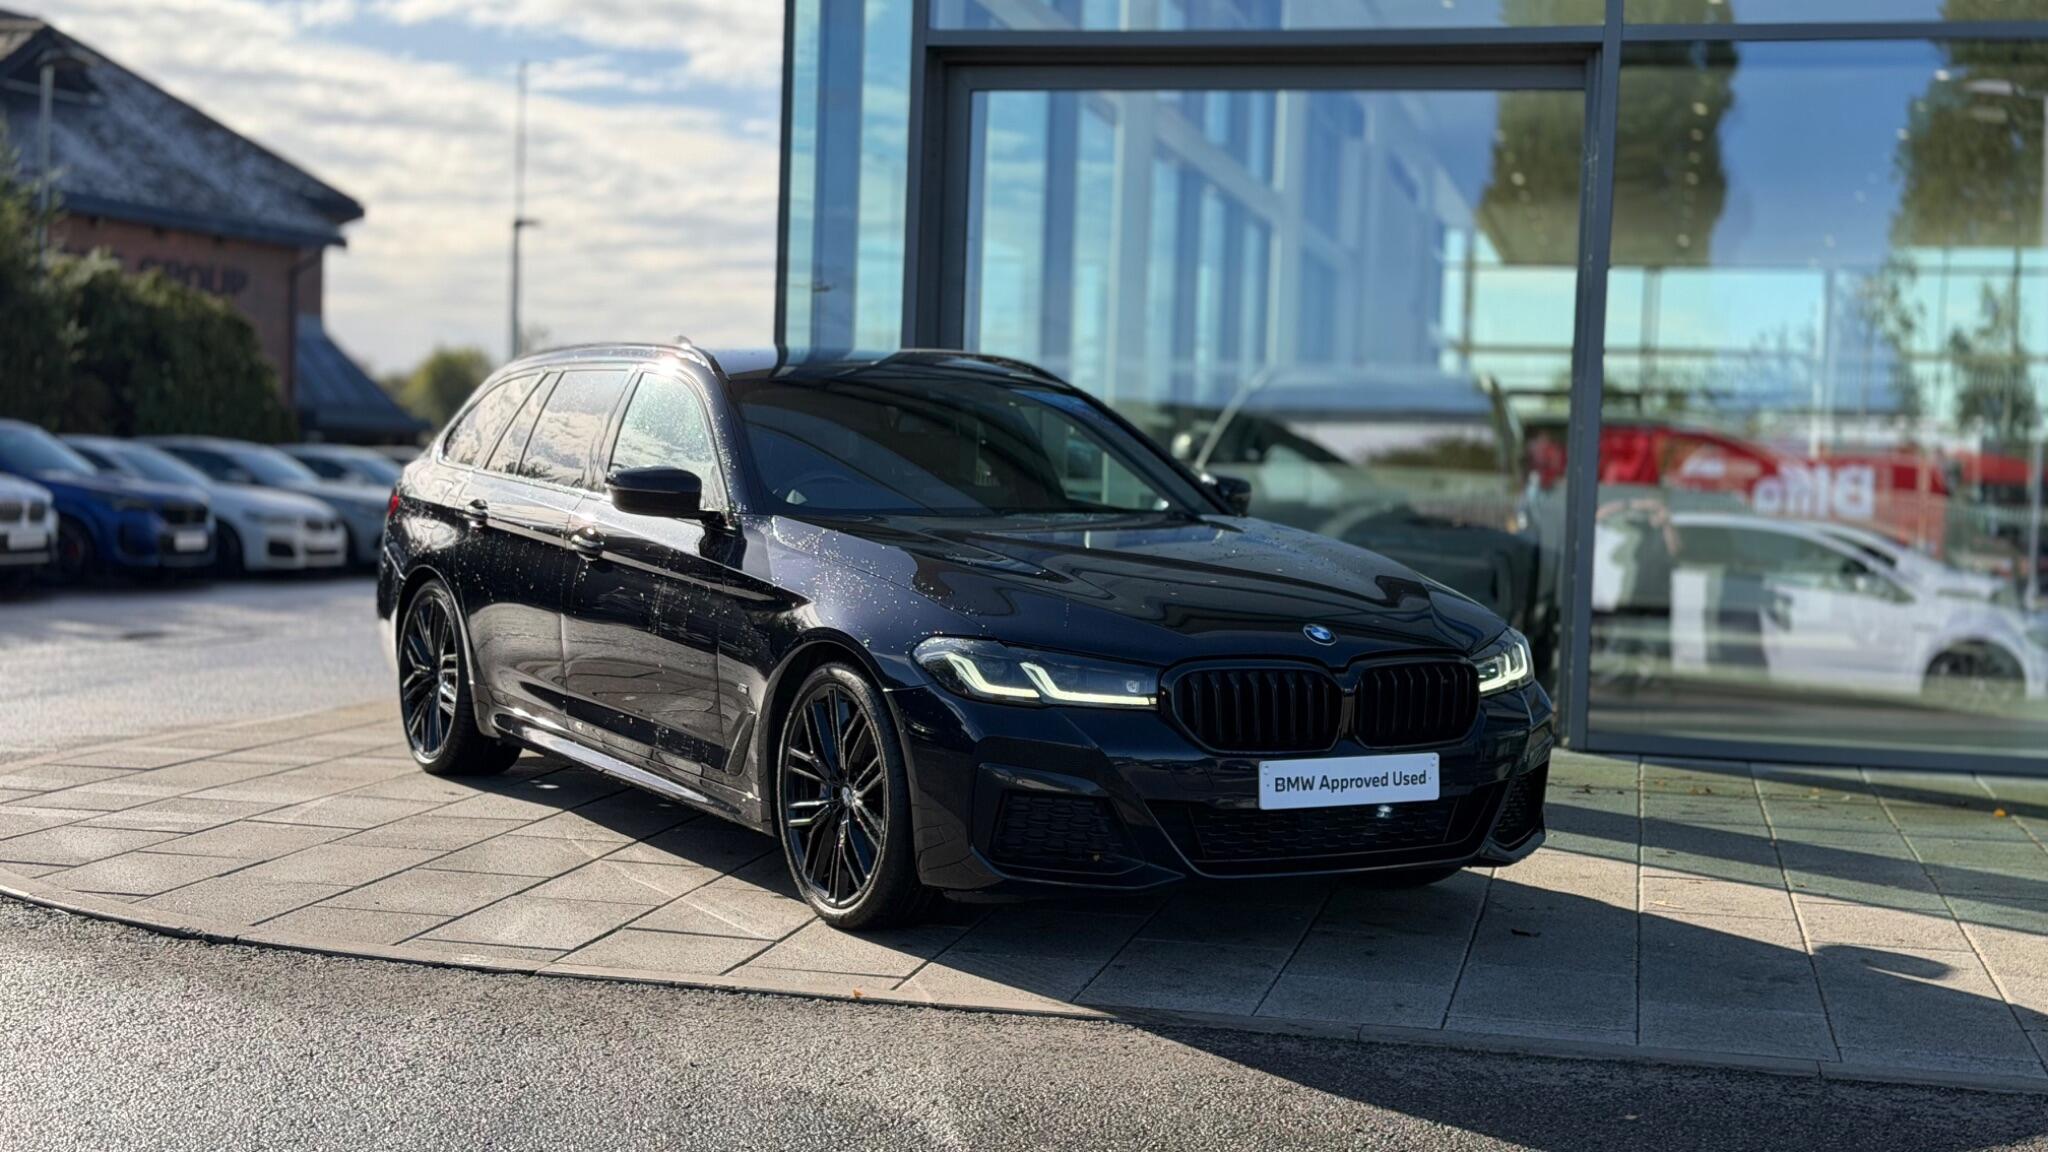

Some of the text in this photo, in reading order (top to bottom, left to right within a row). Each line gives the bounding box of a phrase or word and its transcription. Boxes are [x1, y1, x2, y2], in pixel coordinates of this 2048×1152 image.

[1274, 770, 1427, 793] BMW Approved Used
